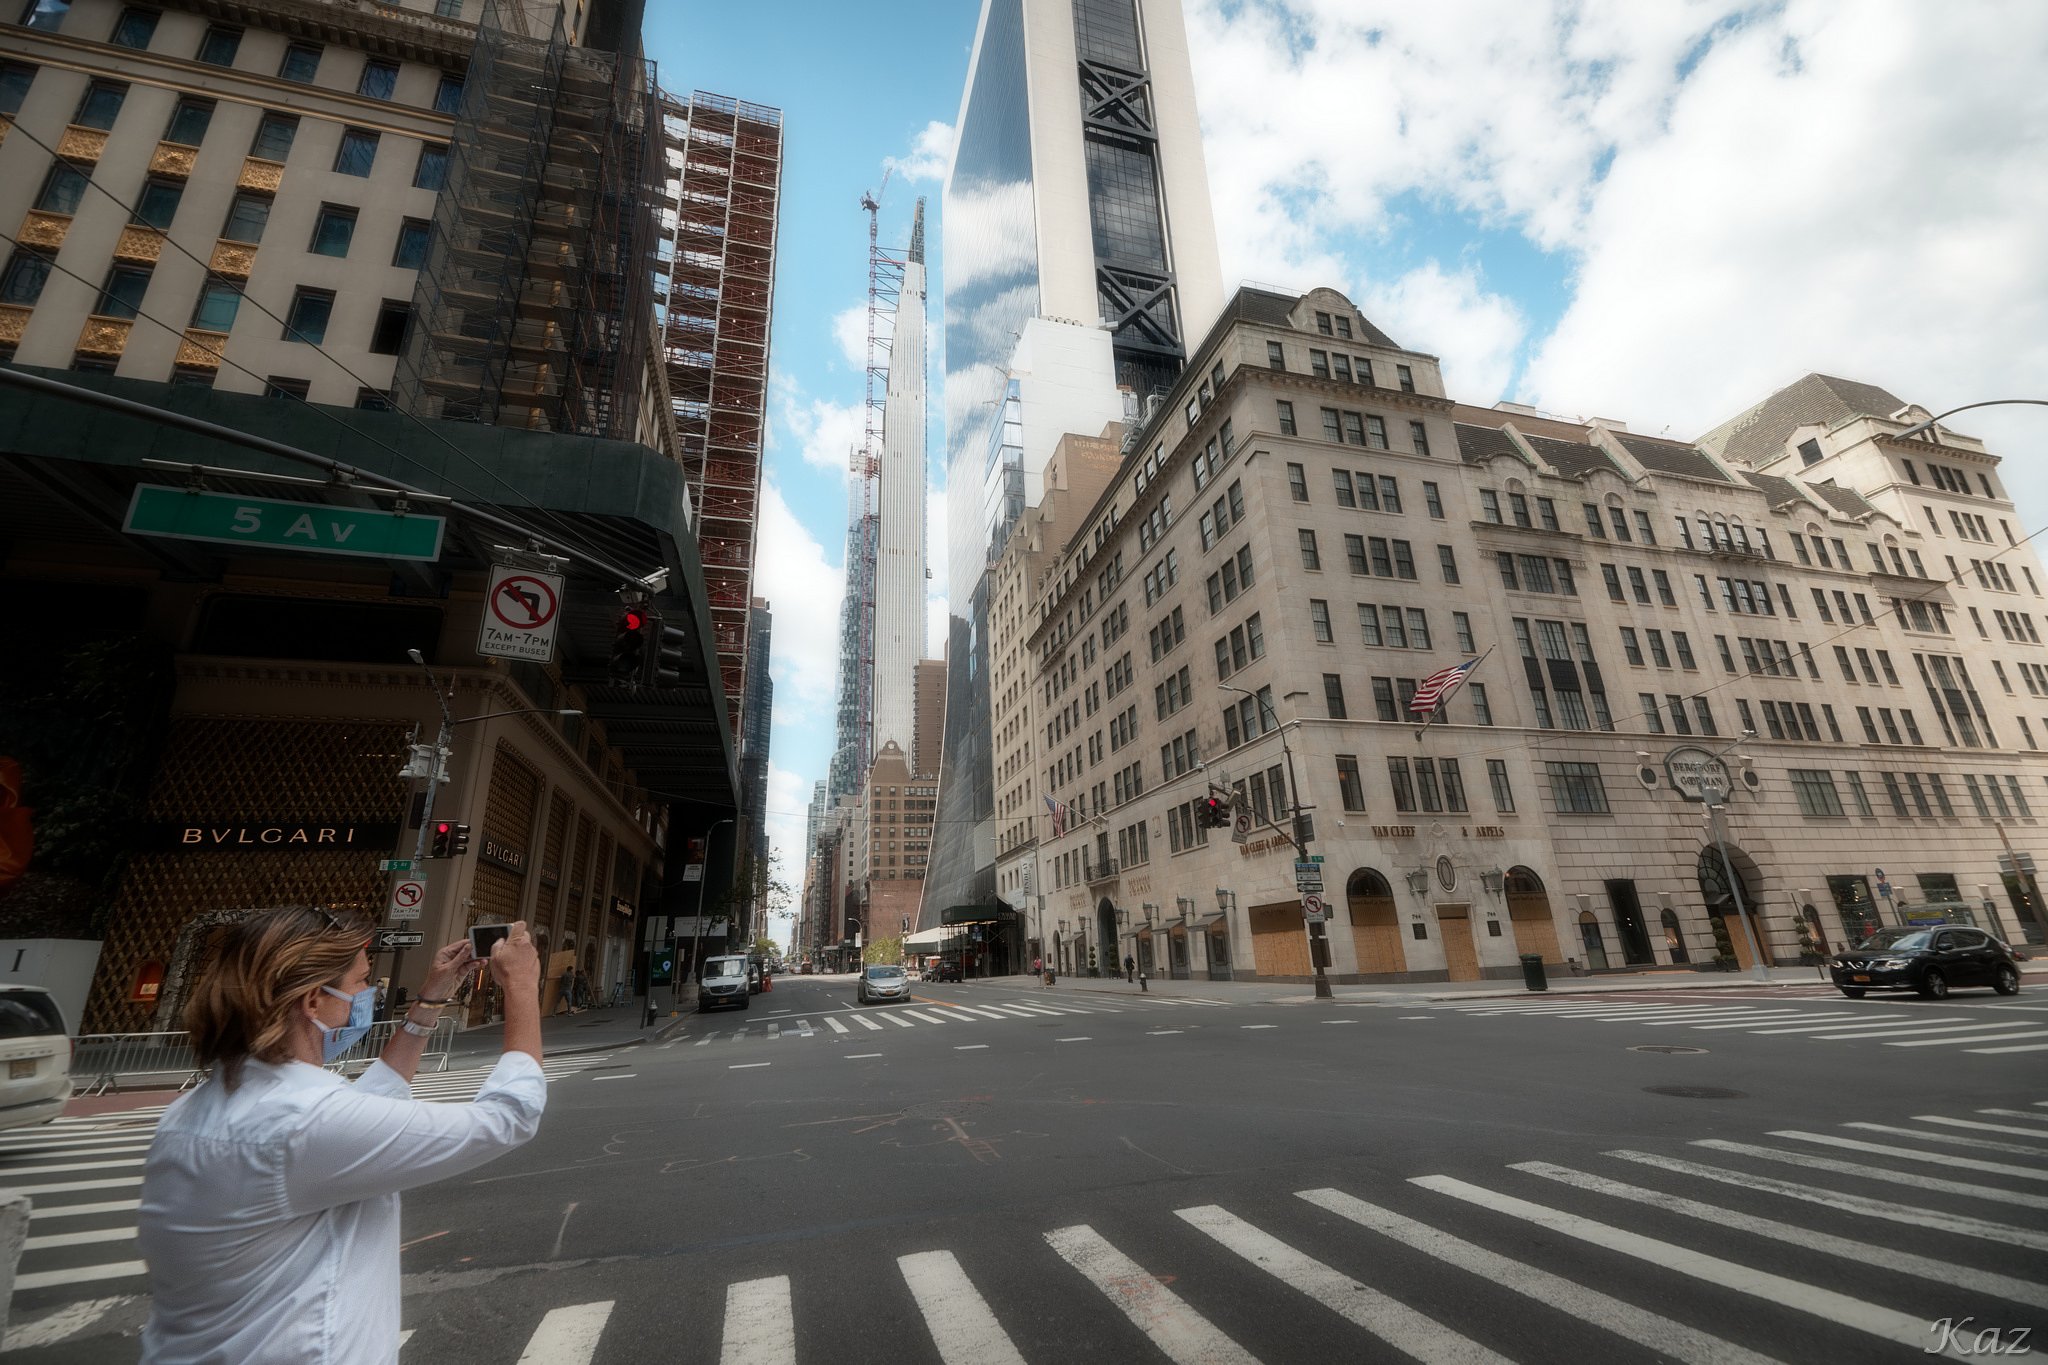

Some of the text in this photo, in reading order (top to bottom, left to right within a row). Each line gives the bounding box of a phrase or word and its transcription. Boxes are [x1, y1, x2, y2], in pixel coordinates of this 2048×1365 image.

[230, 506, 356, 543] 5 Av
[486, 627, 549, 648] 7AM-7PM
[484, 641, 547, 656] EXCEPT BUSES
[182, 828, 354, 844] BVLGARI
[1371, 825, 1390, 838] VAN
[1390, 825, 1416, 838] CLEEF
[1476, 826, 1505, 838] ARPELS
[486, 841, 524, 868] BVLGARI
